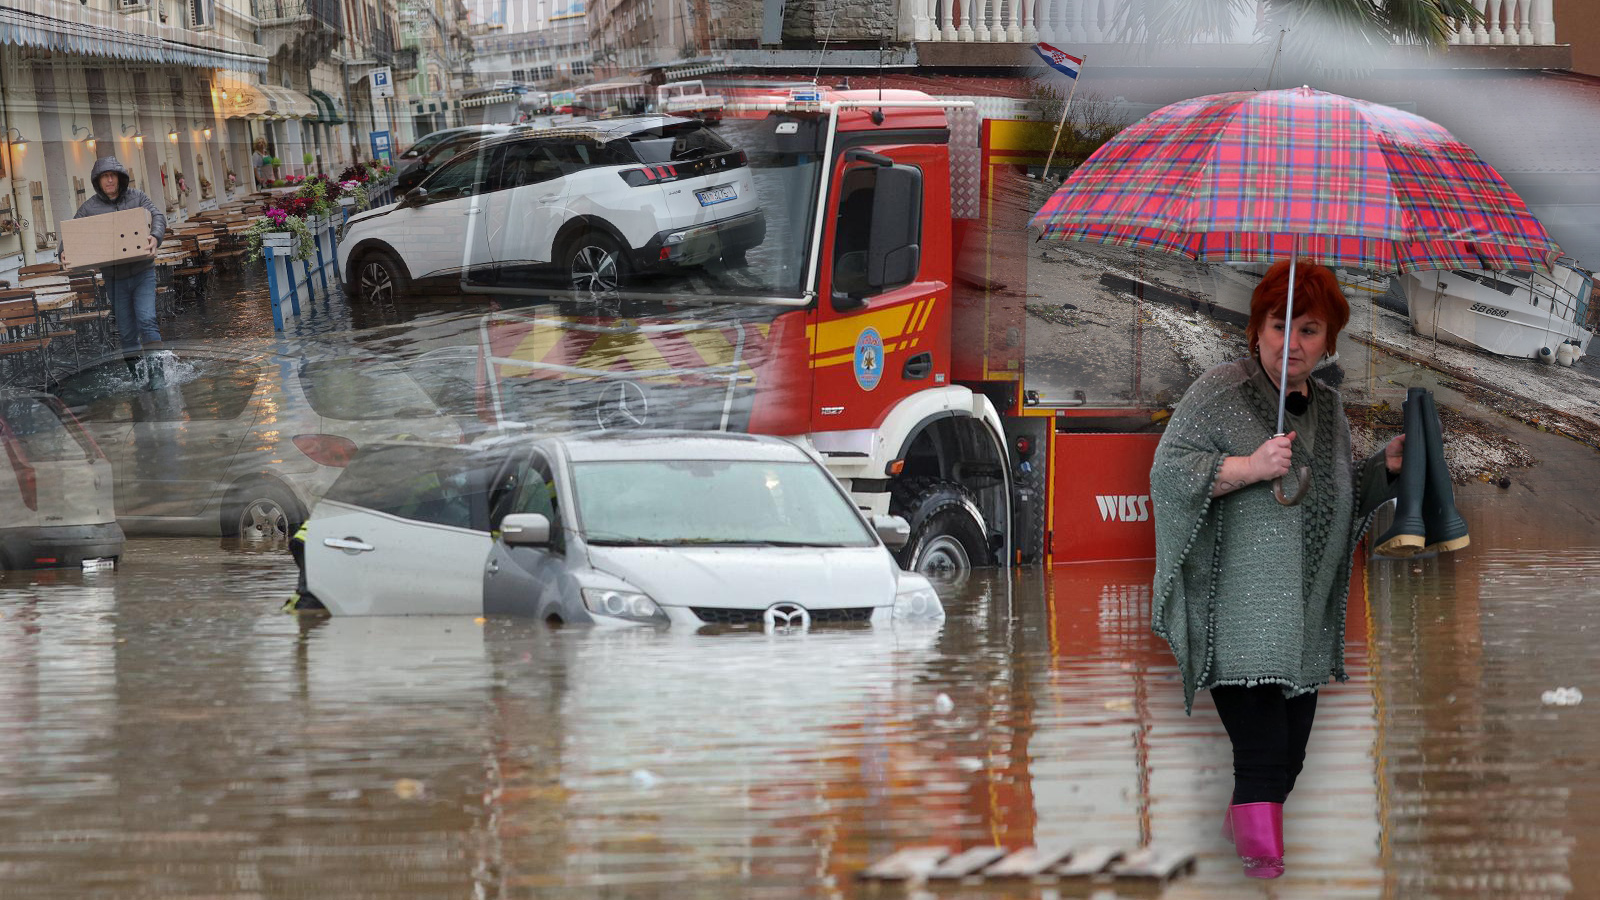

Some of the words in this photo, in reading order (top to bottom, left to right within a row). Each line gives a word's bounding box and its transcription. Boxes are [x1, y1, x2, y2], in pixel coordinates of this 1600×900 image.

[376, 73, 385, 84] P
[1486, 307, 1509, 318] 6688
[1095, 495, 1149, 522] WISS
